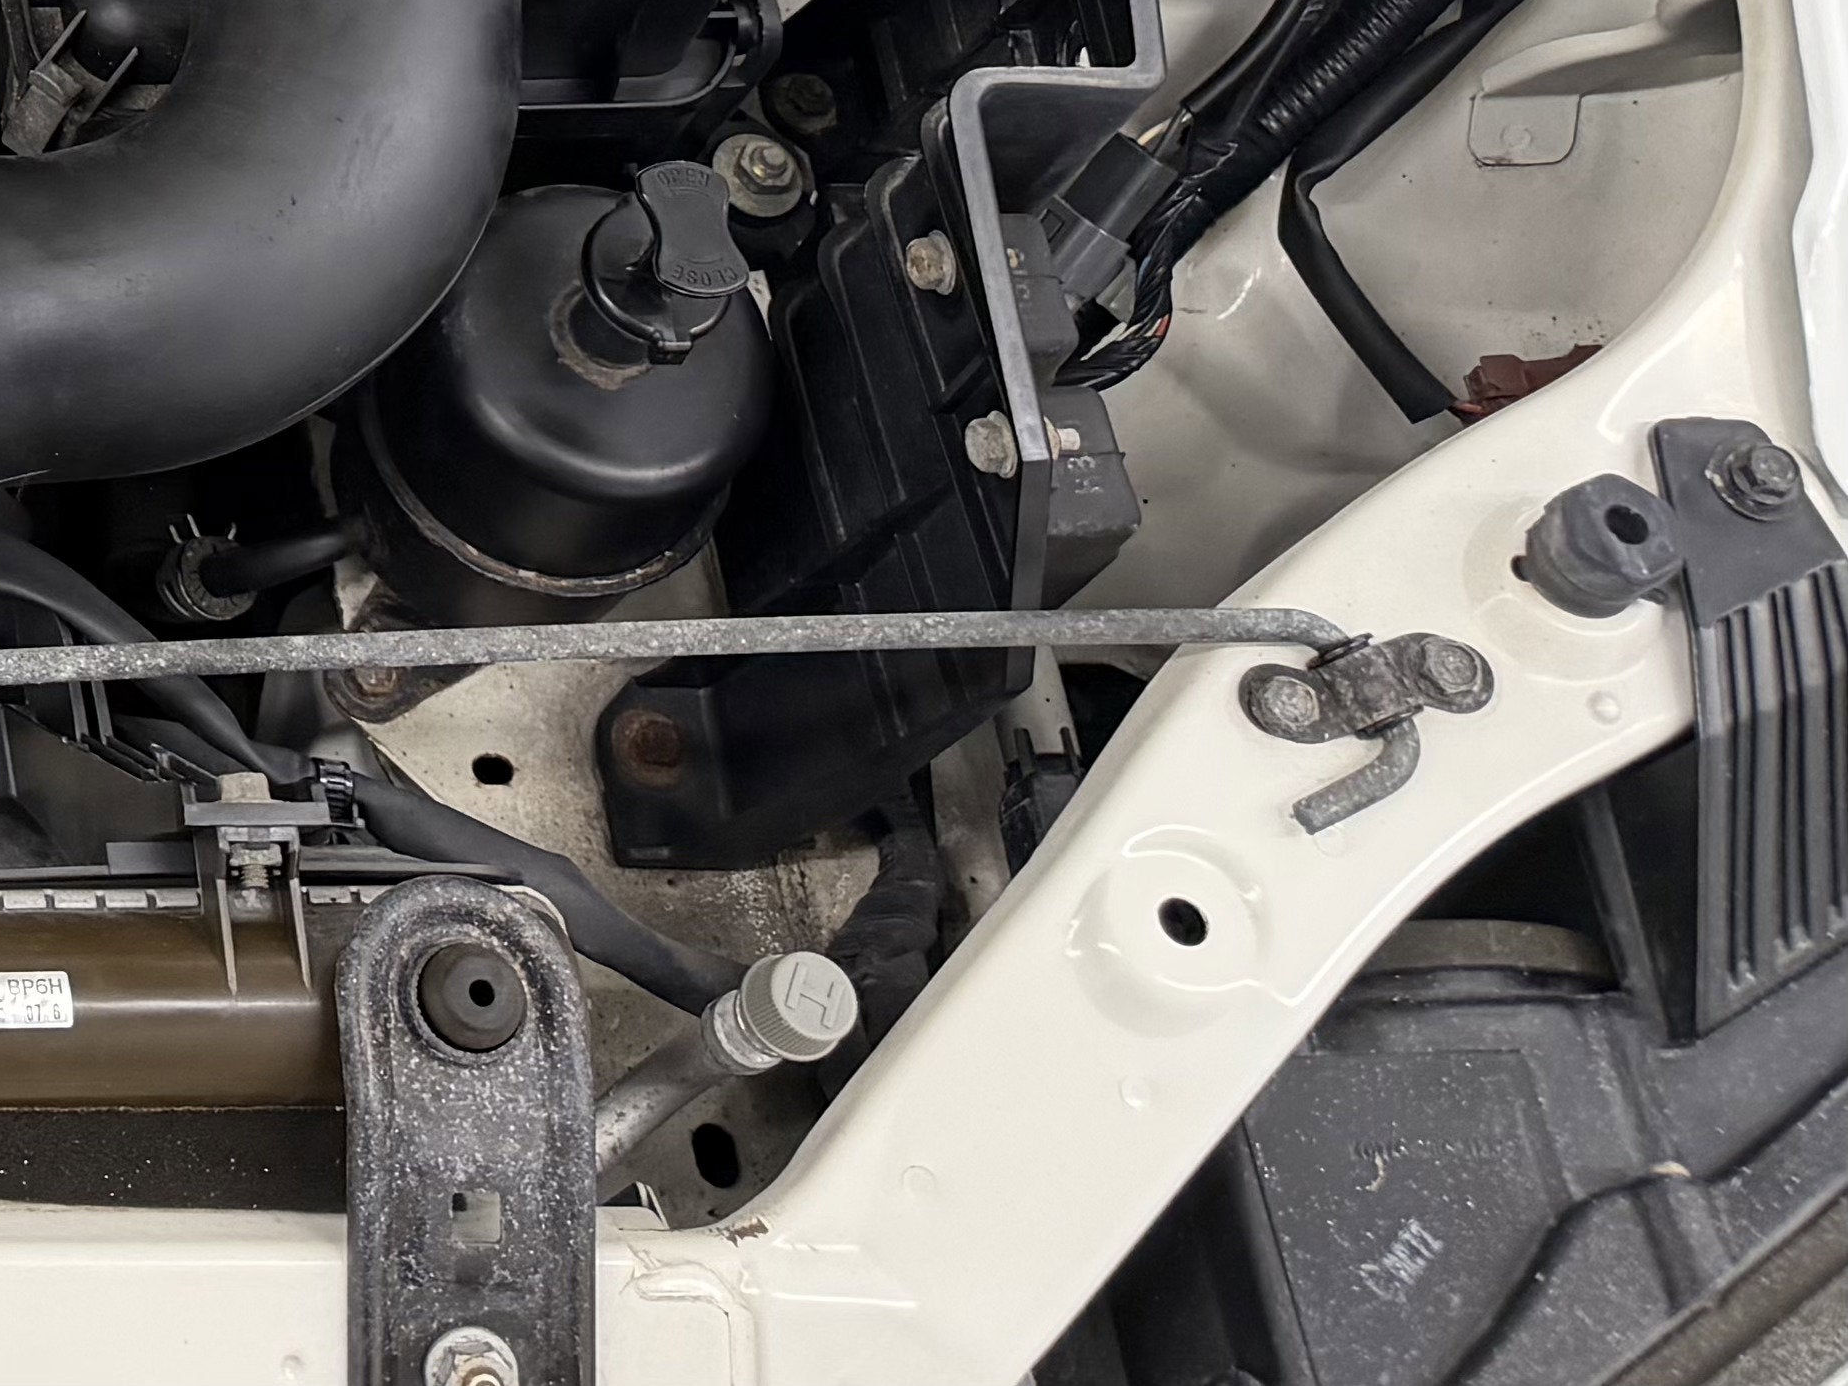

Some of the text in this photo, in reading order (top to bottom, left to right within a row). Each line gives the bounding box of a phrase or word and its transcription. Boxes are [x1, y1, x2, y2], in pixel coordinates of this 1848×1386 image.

[672, 264, 738, 287] CLOSE
[7, 977, 63, 996] BP6H
[785, 961, 844, 1030] H
